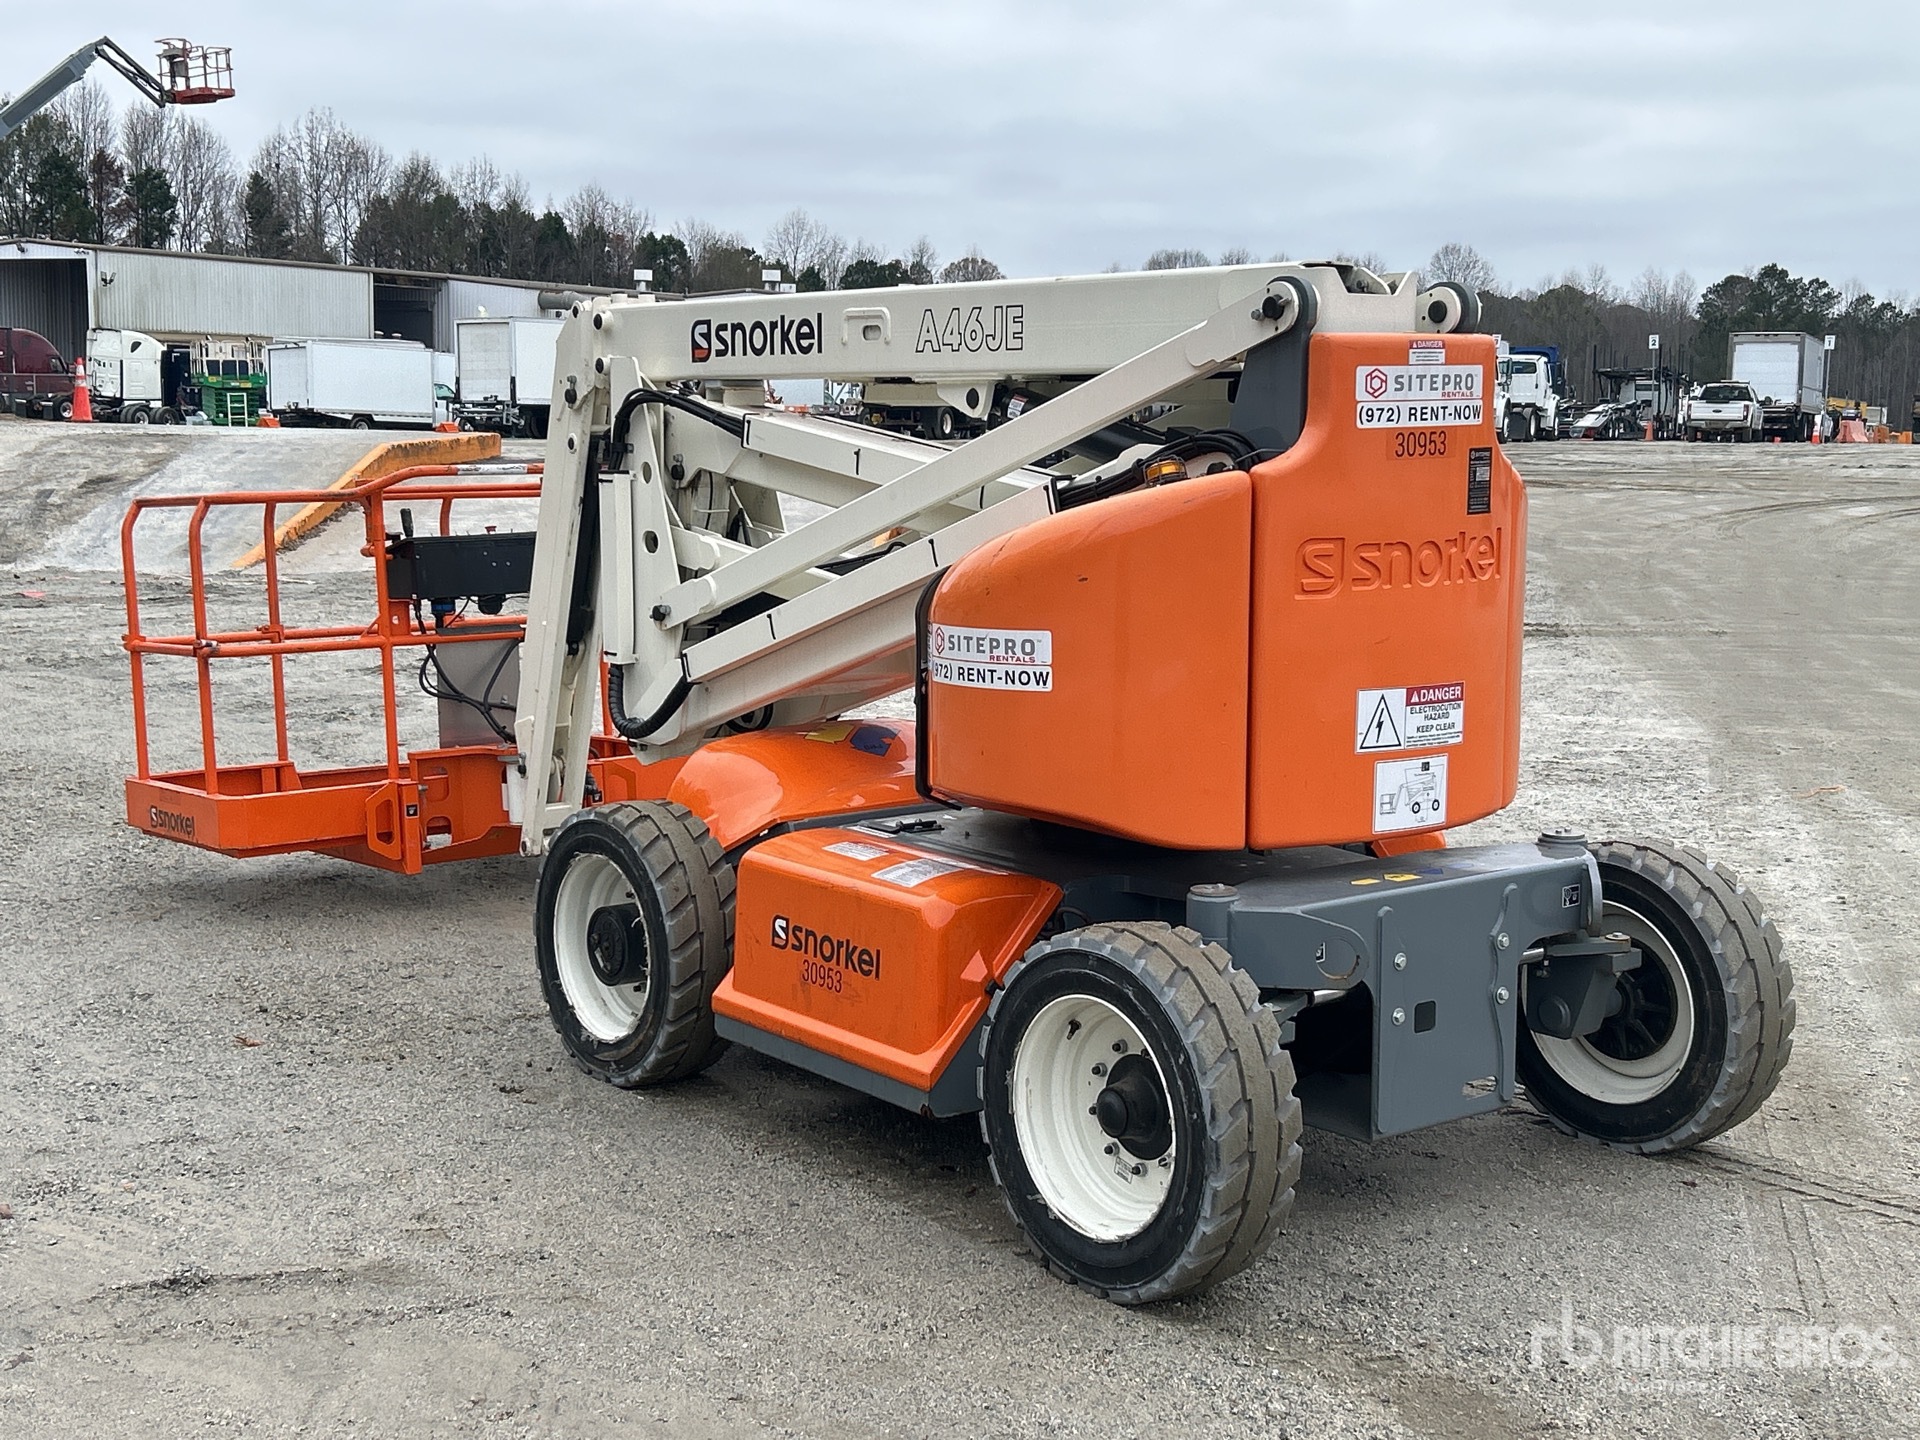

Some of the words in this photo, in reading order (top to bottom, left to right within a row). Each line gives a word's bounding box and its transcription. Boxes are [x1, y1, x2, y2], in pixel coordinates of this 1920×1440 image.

[714, 312, 823, 358] snorkel
[915, 304, 1024, 354] A46JE
[1417, 340, 1443, 348] DANGER
[1651, 339, 1657, 347] 2
[1394, 373, 1474, 392] SITEPRO
[1358, 405, 1401, 425] (972)
[1408, 404, 1481, 422] RENT-NOW
[1395, 430, 1447, 457] 30953
[1351, 527, 1502, 591] snorkel
[948, 634, 1036, 656] SITEPRO
[989, 655, 1036, 663] RENTALS
[957, 666, 1050, 687] RENT-NOW
[1420, 686, 1462, 702] DANGER
[1409, 702, 1462, 715] ELECTROCUTION
[1424, 711, 1450, 721] HAZARD
[1416, 724, 1434, 734] KEEP
[1435, 722, 1456, 731] CLEAR
[158, 809, 196, 840] snorkel
[791, 924, 881, 981] snorkel
[802, 959, 843, 993] 30953
